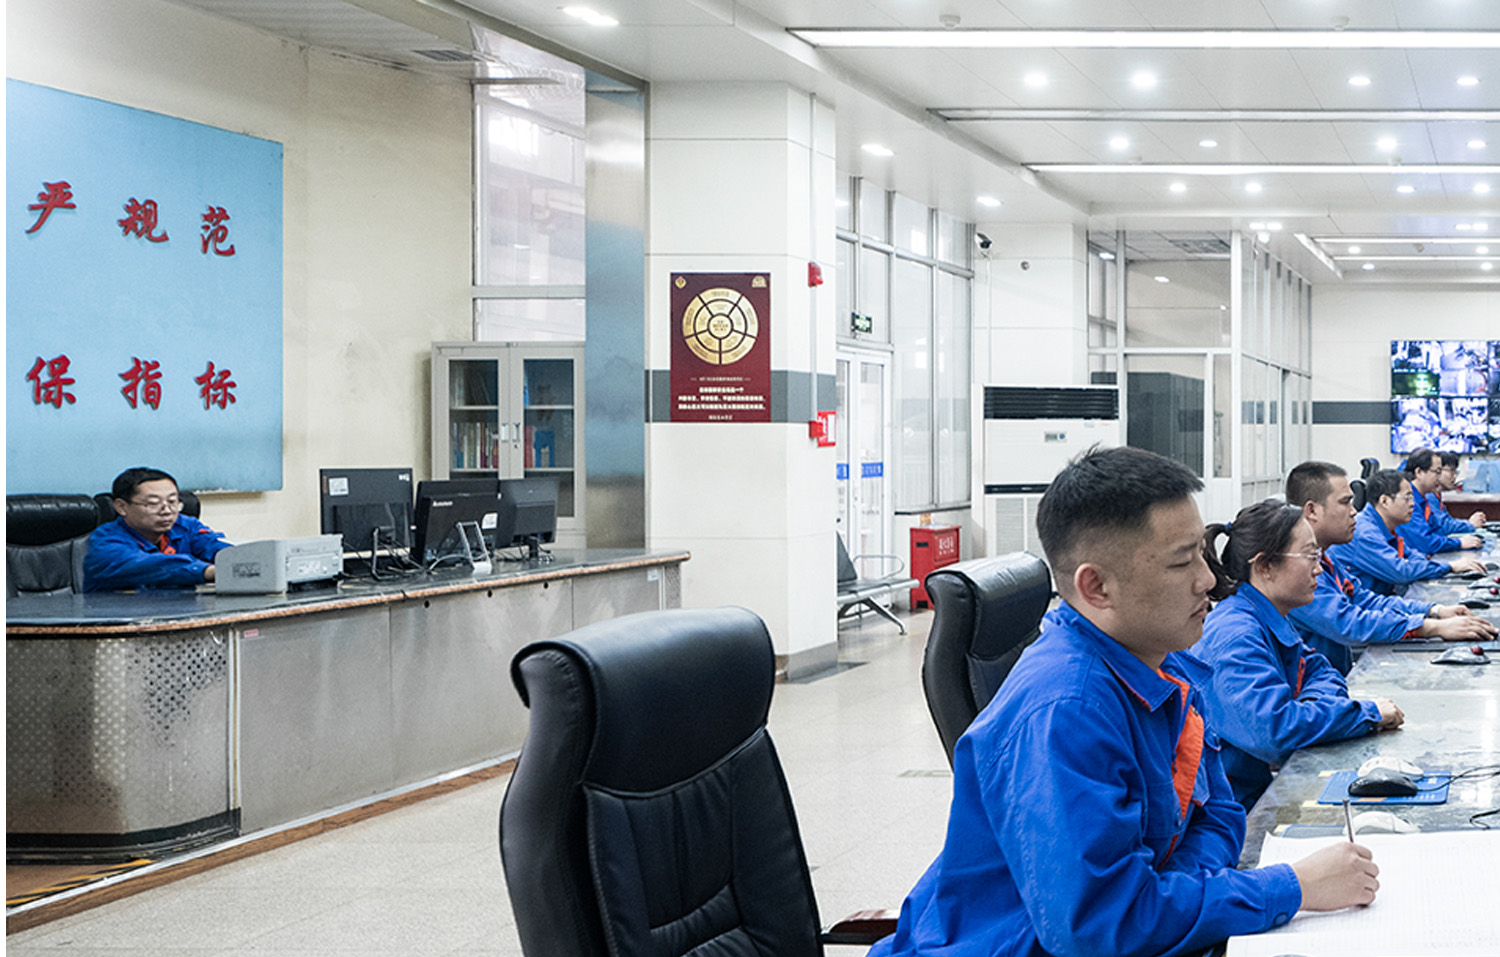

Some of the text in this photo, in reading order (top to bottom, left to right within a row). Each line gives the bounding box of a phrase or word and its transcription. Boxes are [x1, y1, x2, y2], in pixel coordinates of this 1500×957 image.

[25, 180, 236, 257] 严规范
[25, 353, 237, 411] 保指标
